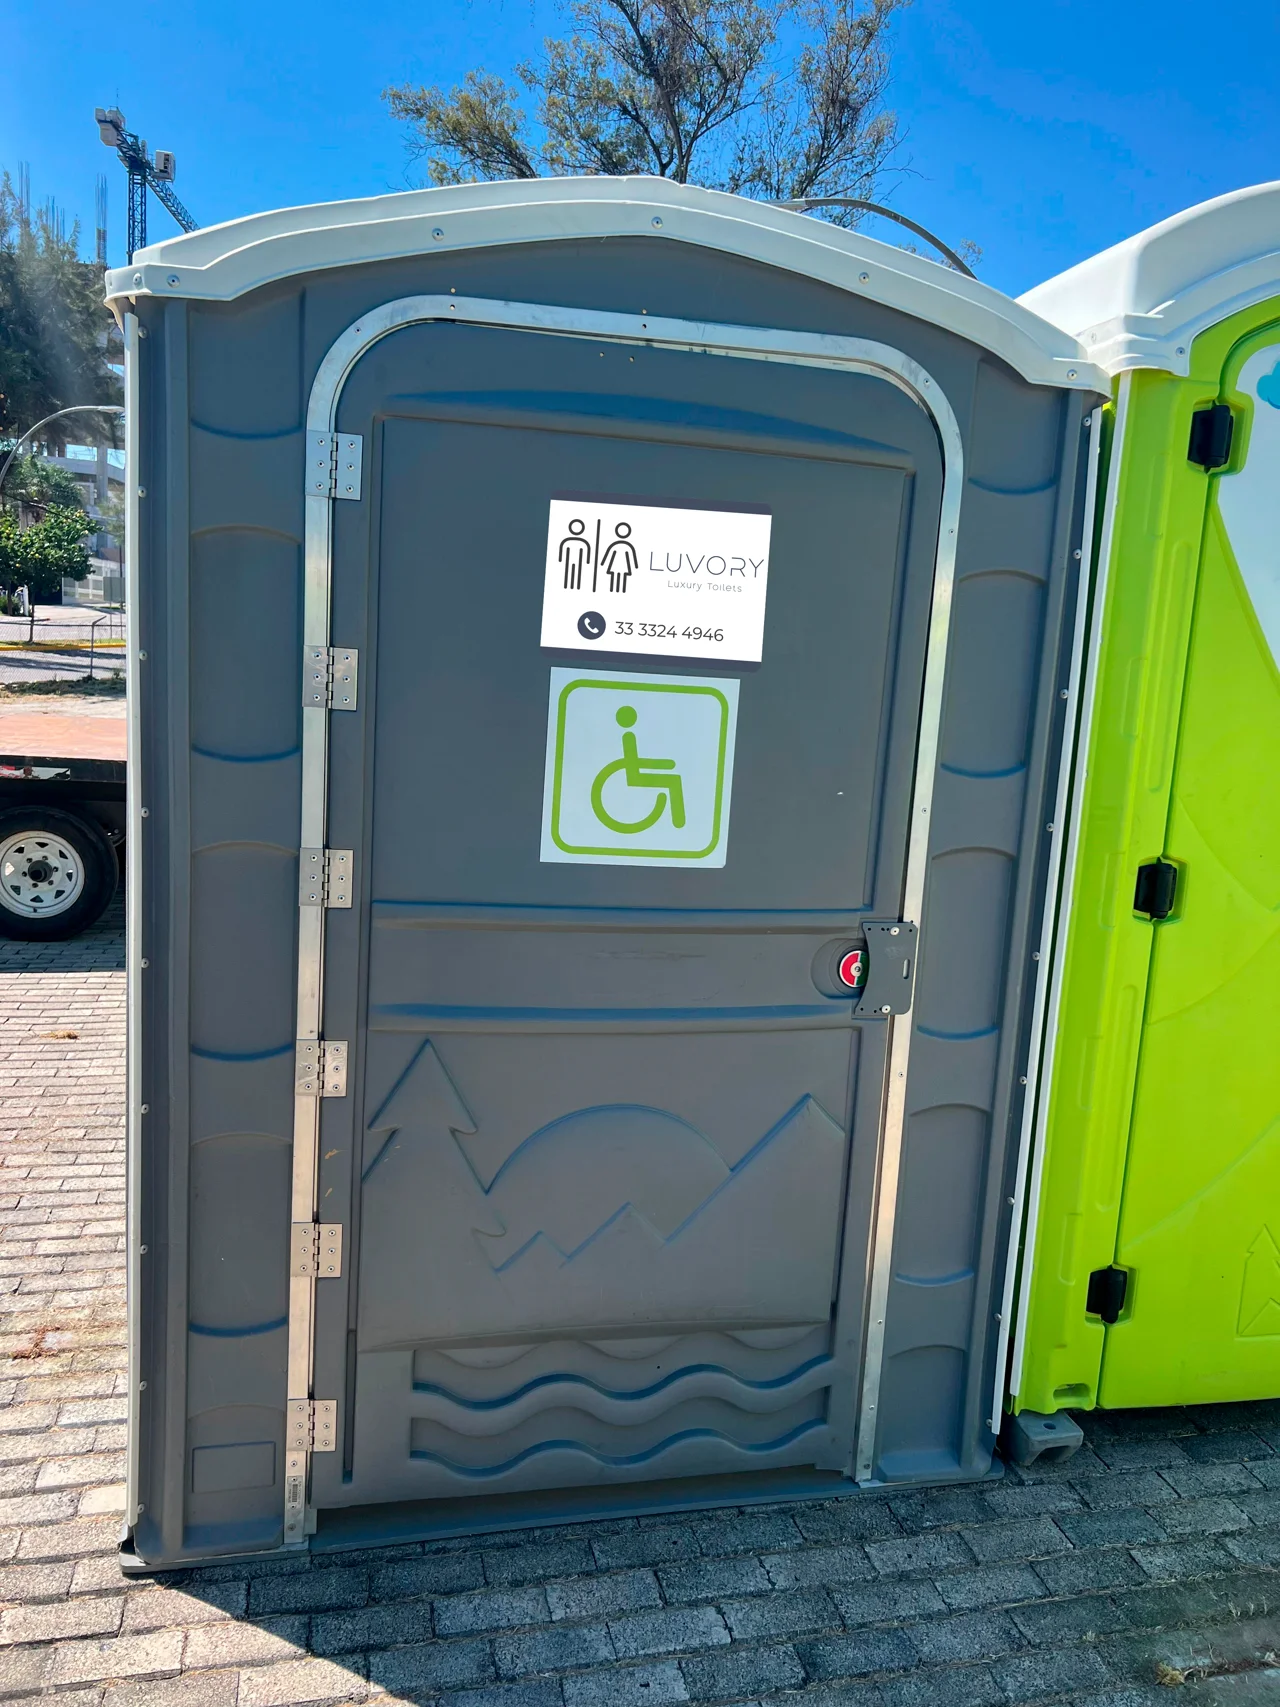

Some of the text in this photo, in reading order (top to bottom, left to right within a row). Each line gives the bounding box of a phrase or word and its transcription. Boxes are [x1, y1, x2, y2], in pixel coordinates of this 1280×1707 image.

[649, 551, 765, 578] LUVORY
[667, 580, 743, 593] Luxury Toilets
[614, 621, 724, 642] 33 3324 4946
